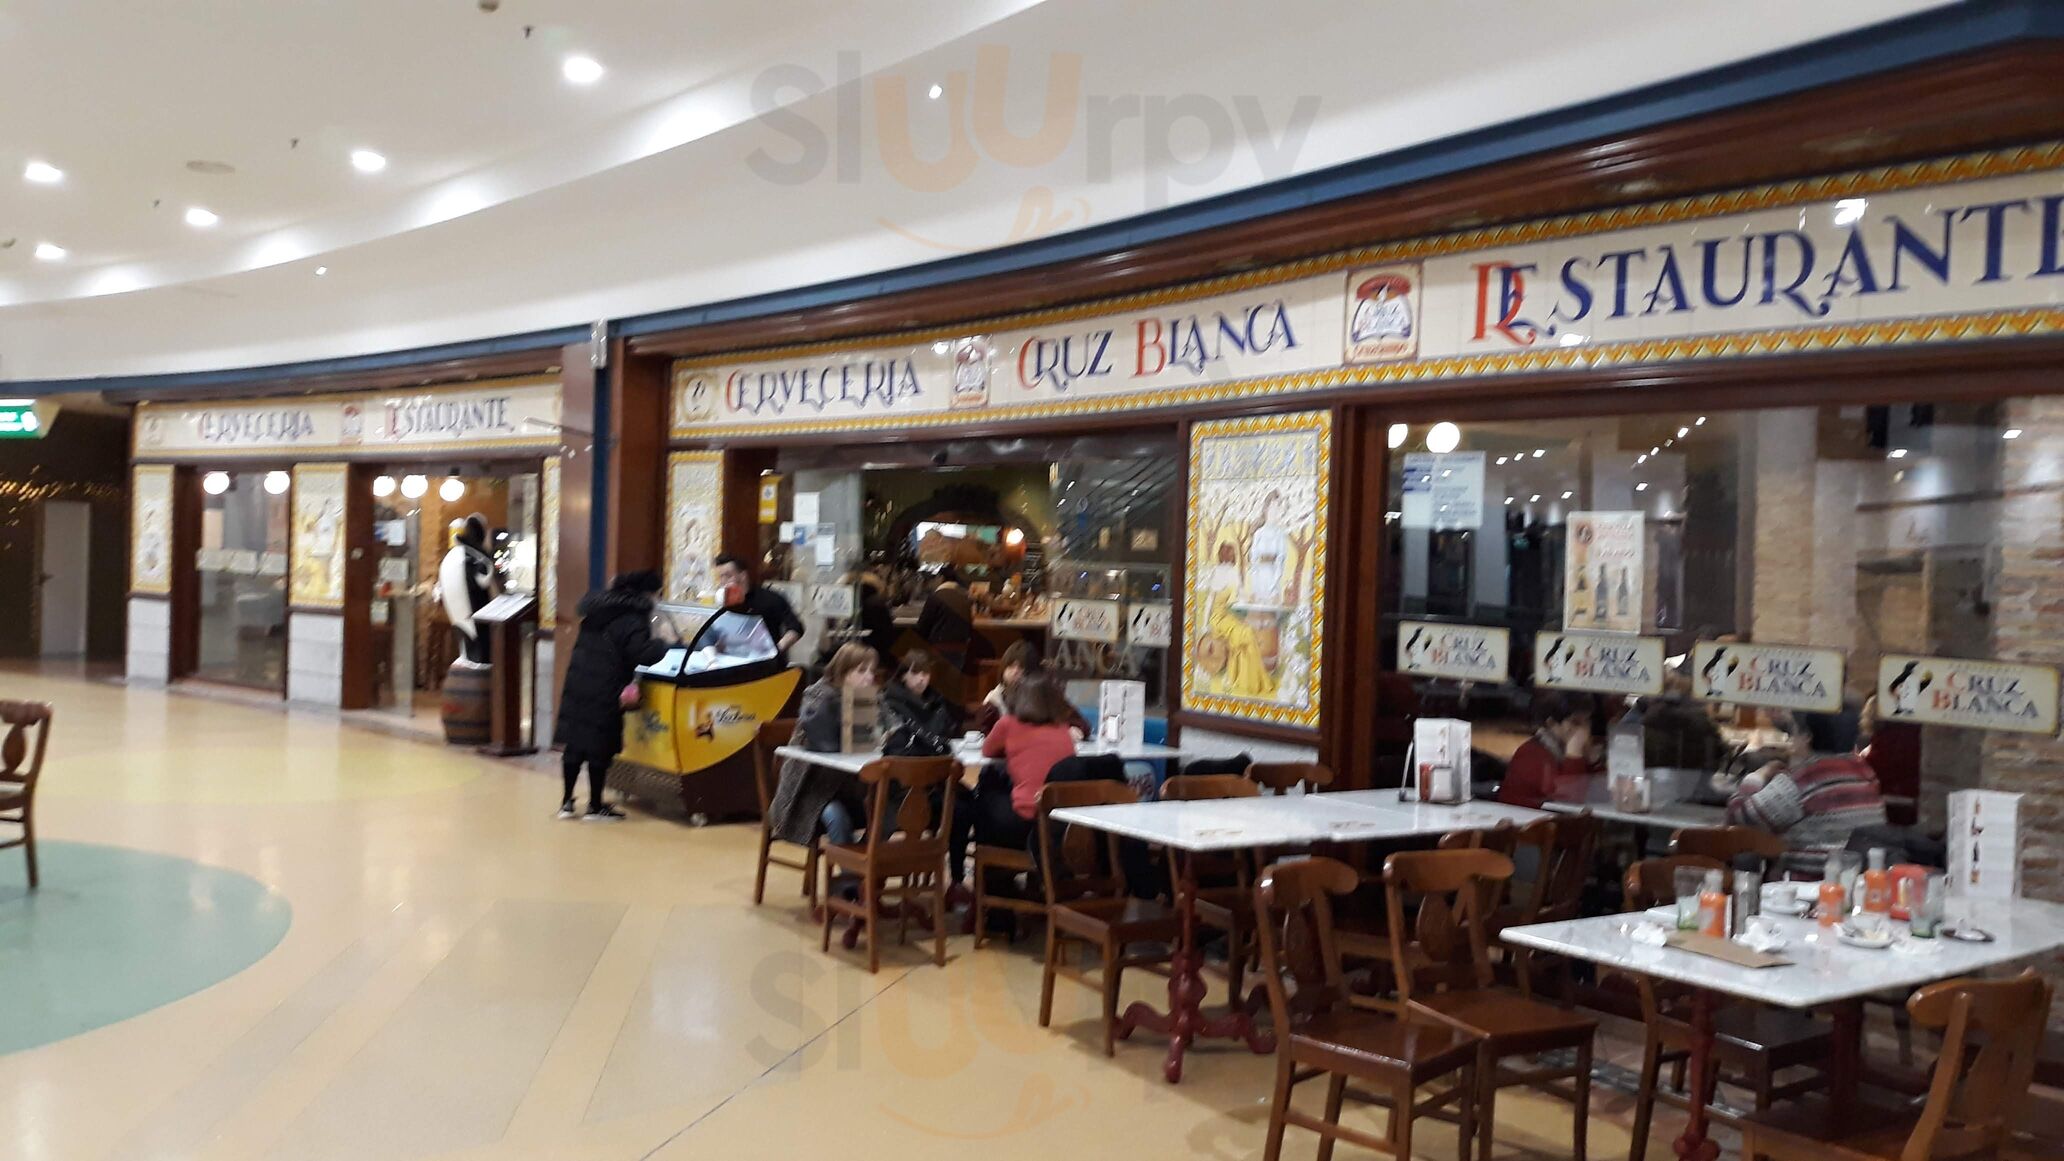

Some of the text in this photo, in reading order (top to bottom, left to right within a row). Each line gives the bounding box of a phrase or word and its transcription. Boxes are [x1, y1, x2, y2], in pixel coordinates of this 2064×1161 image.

[725, 299, 1302, 415] CERVECERIA CRUZ BLANCA
[1750, 655, 1815, 679] CRUZ
[1737, 671, 1827, 698] BLANCA
[1946, 671, 2025, 697] CRUZ
[1932, 689, 2040, 719] BLANCA
